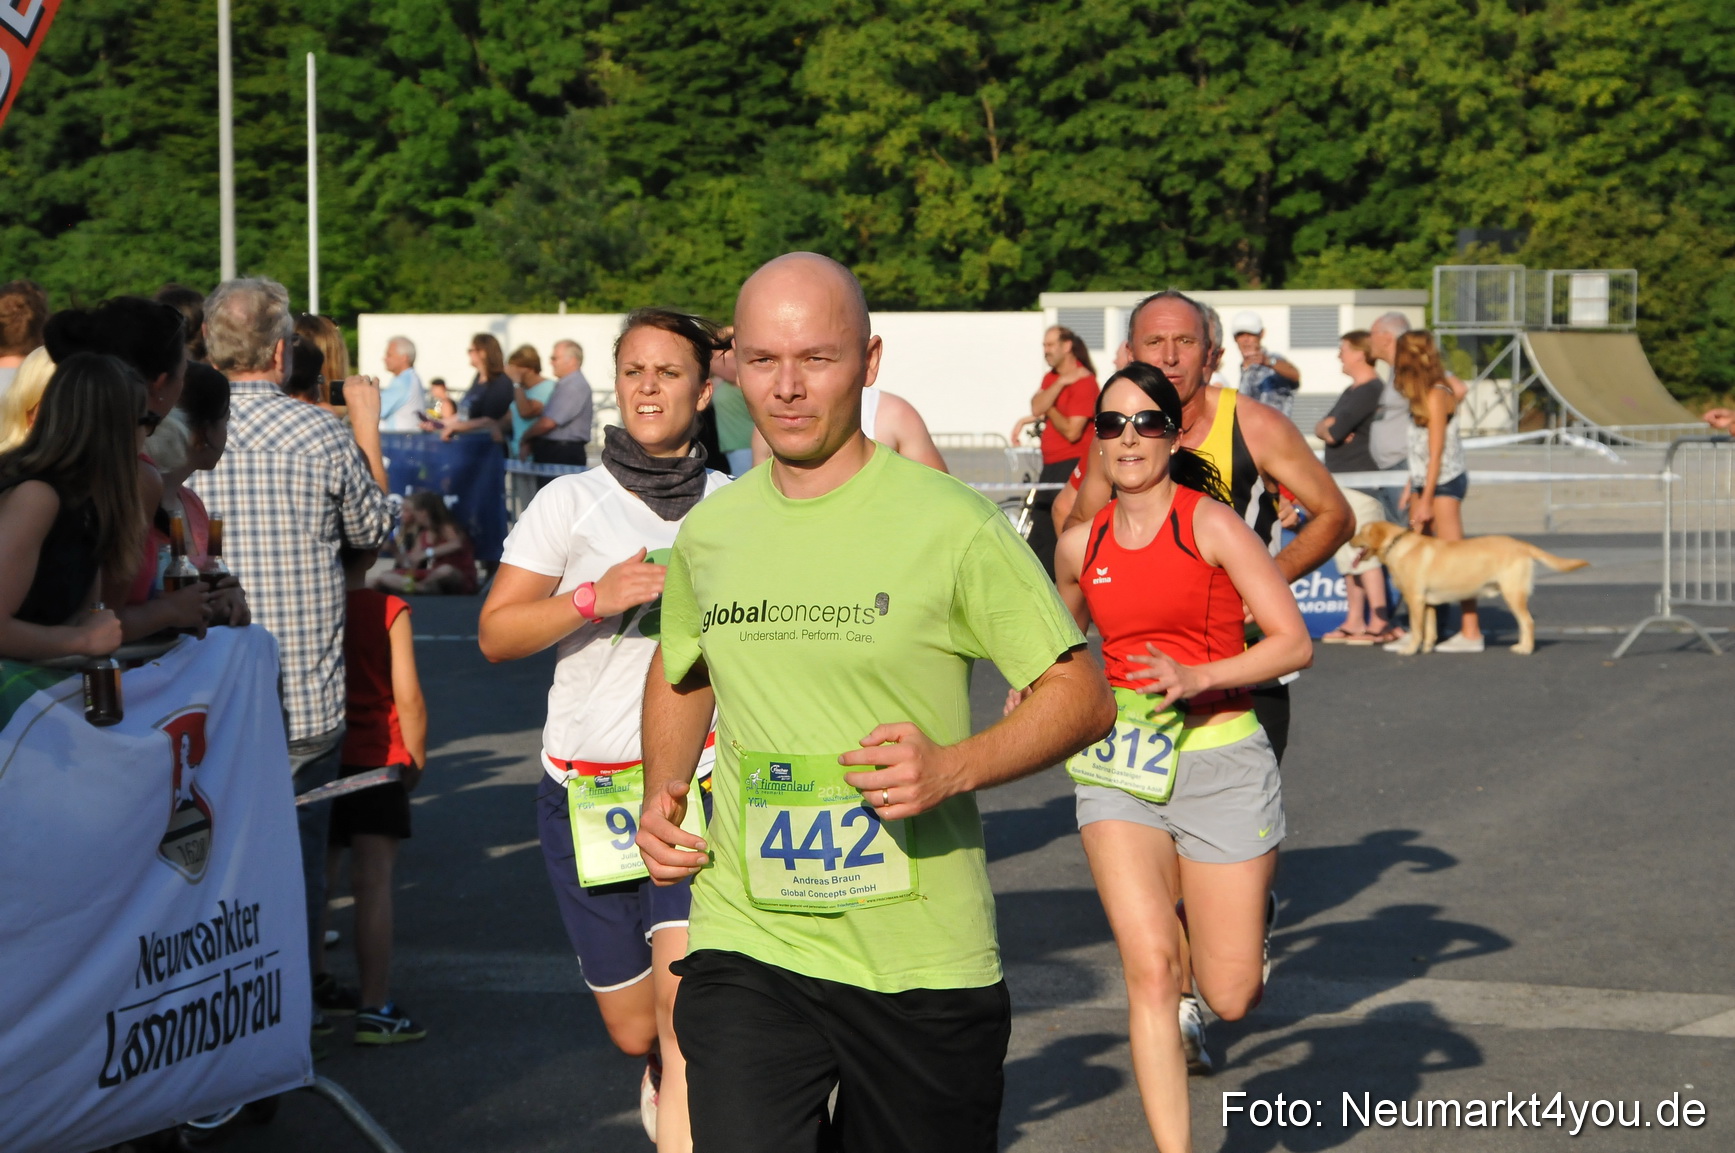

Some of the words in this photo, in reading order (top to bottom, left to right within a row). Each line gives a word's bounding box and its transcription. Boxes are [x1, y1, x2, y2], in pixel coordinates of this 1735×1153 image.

[1092, 576, 1111, 584] erima
[702, 599, 876, 633] globalconcepts
[739, 630, 798, 642] Understand.
[801, 629, 842, 641] Perform.
[846, 630, 875, 643] Care.
[1082, 726, 1173, 776] 312
[589, 782, 631, 796] firmenlauf
[761, 779, 815, 792] firmenlauf
[605, 804, 643, 850] 9
[759, 806, 884, 871] 442
[621, 852, 638, 860] Julia
[621, 861, 644, 870] BIONO
[793, 875, 830, 886] Andreas
[831, 874, 861, 884] Braun
[780, 888, 806, 897] Global
[808, 889, 847, 899] Concepts
[849, 884, 877, 895] GmbH
[135, 898, 260, 989] Neumarkter
[98, 956, 282, 1089] Lammsbräu
